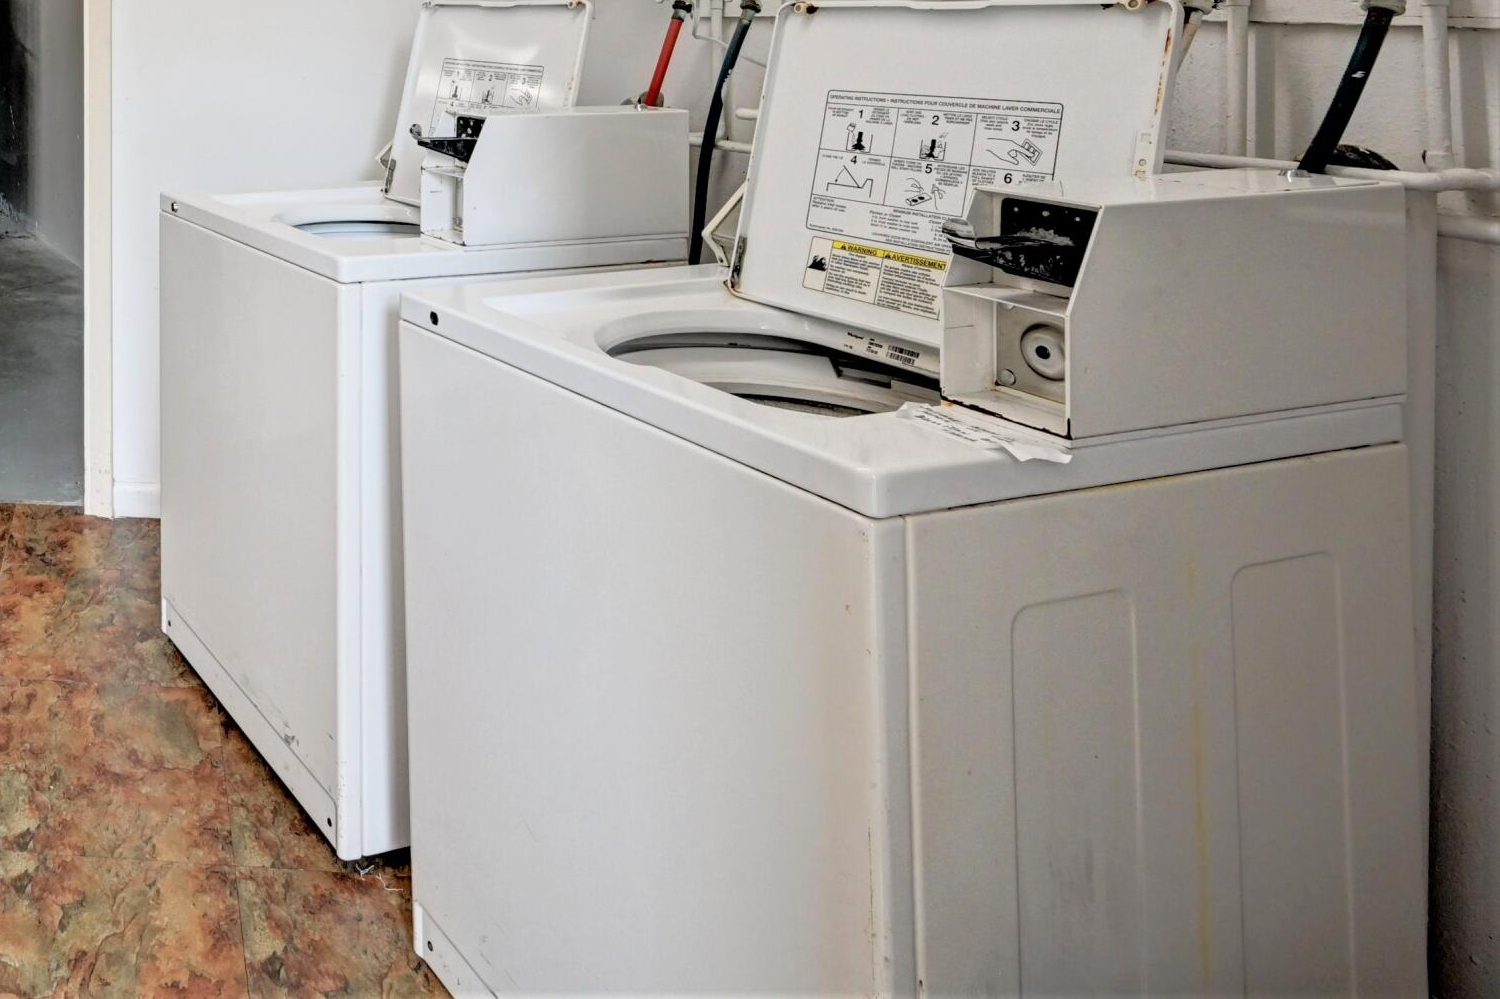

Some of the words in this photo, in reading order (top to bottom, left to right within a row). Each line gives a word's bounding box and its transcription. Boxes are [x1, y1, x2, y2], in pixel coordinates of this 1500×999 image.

[858, 109, 864, 119] 1
[931, 115, 940, 125] 2
[1011, 120, 1020, 132] 3
[850, 155, 857, 165] 4
[924, 163, 933, 174] 5
[1003, 172, 1013, 184] 6
[847, 244, 878, 256] WARNING
[892, 253, 947, 271] AVERTISSEMENT
